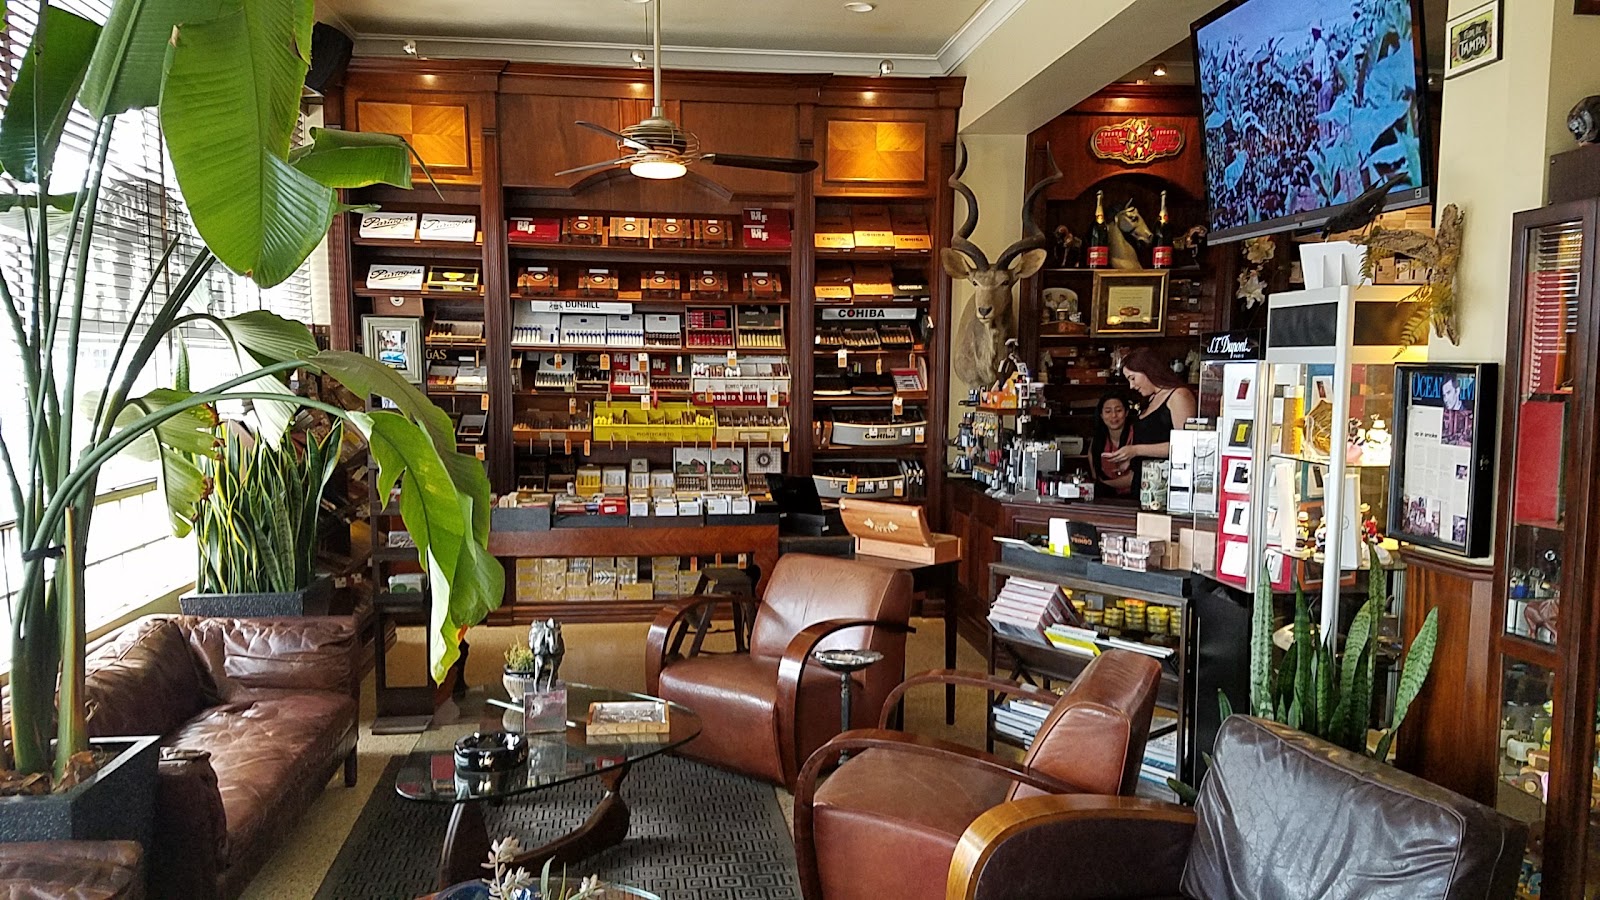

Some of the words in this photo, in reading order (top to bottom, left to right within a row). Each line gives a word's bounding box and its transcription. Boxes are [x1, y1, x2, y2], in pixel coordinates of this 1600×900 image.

[1460, 35, 1485, 56] TAMPA
[565, 301, 600, 309] DUNHILL
[838, 309, 885, 318] COHIBA
